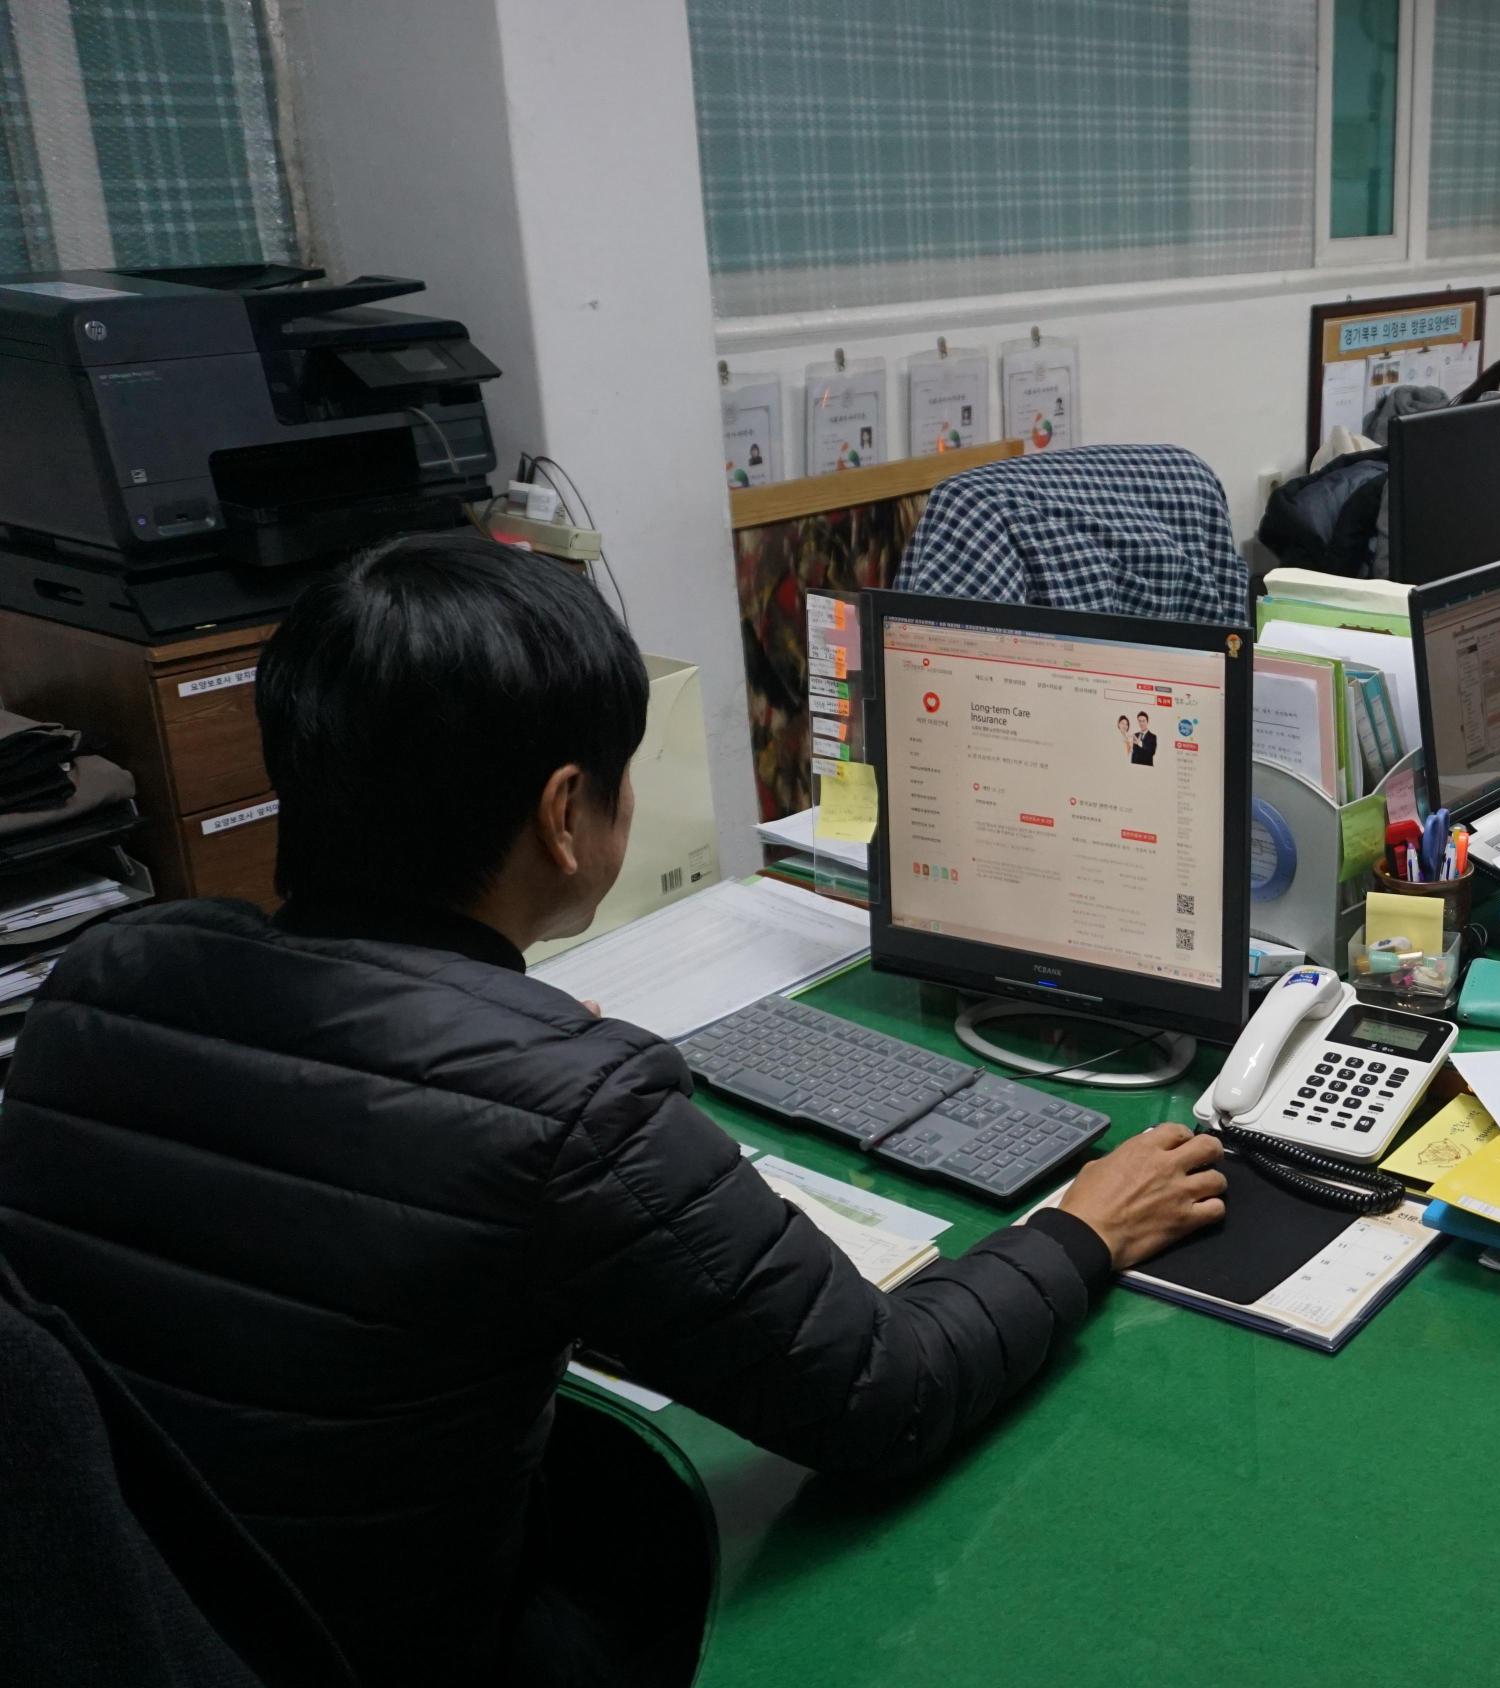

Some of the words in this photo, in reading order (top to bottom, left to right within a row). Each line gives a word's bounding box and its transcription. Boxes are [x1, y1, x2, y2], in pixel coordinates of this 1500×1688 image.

[1344, 324, 1378, 345] 경기북부
[1383, 320, 1408, 338] 의정부
[1411, 314, 1457, 335] 방문요양센터
[191, 675, 231, 691] 요양보호사
[971, 702, 1011, 715] Long-term
[1012, 707, 1031, 718] Care
[971, 713, 1007, 726] Insurance
[213, 811, 254, 829] 요양보호사
